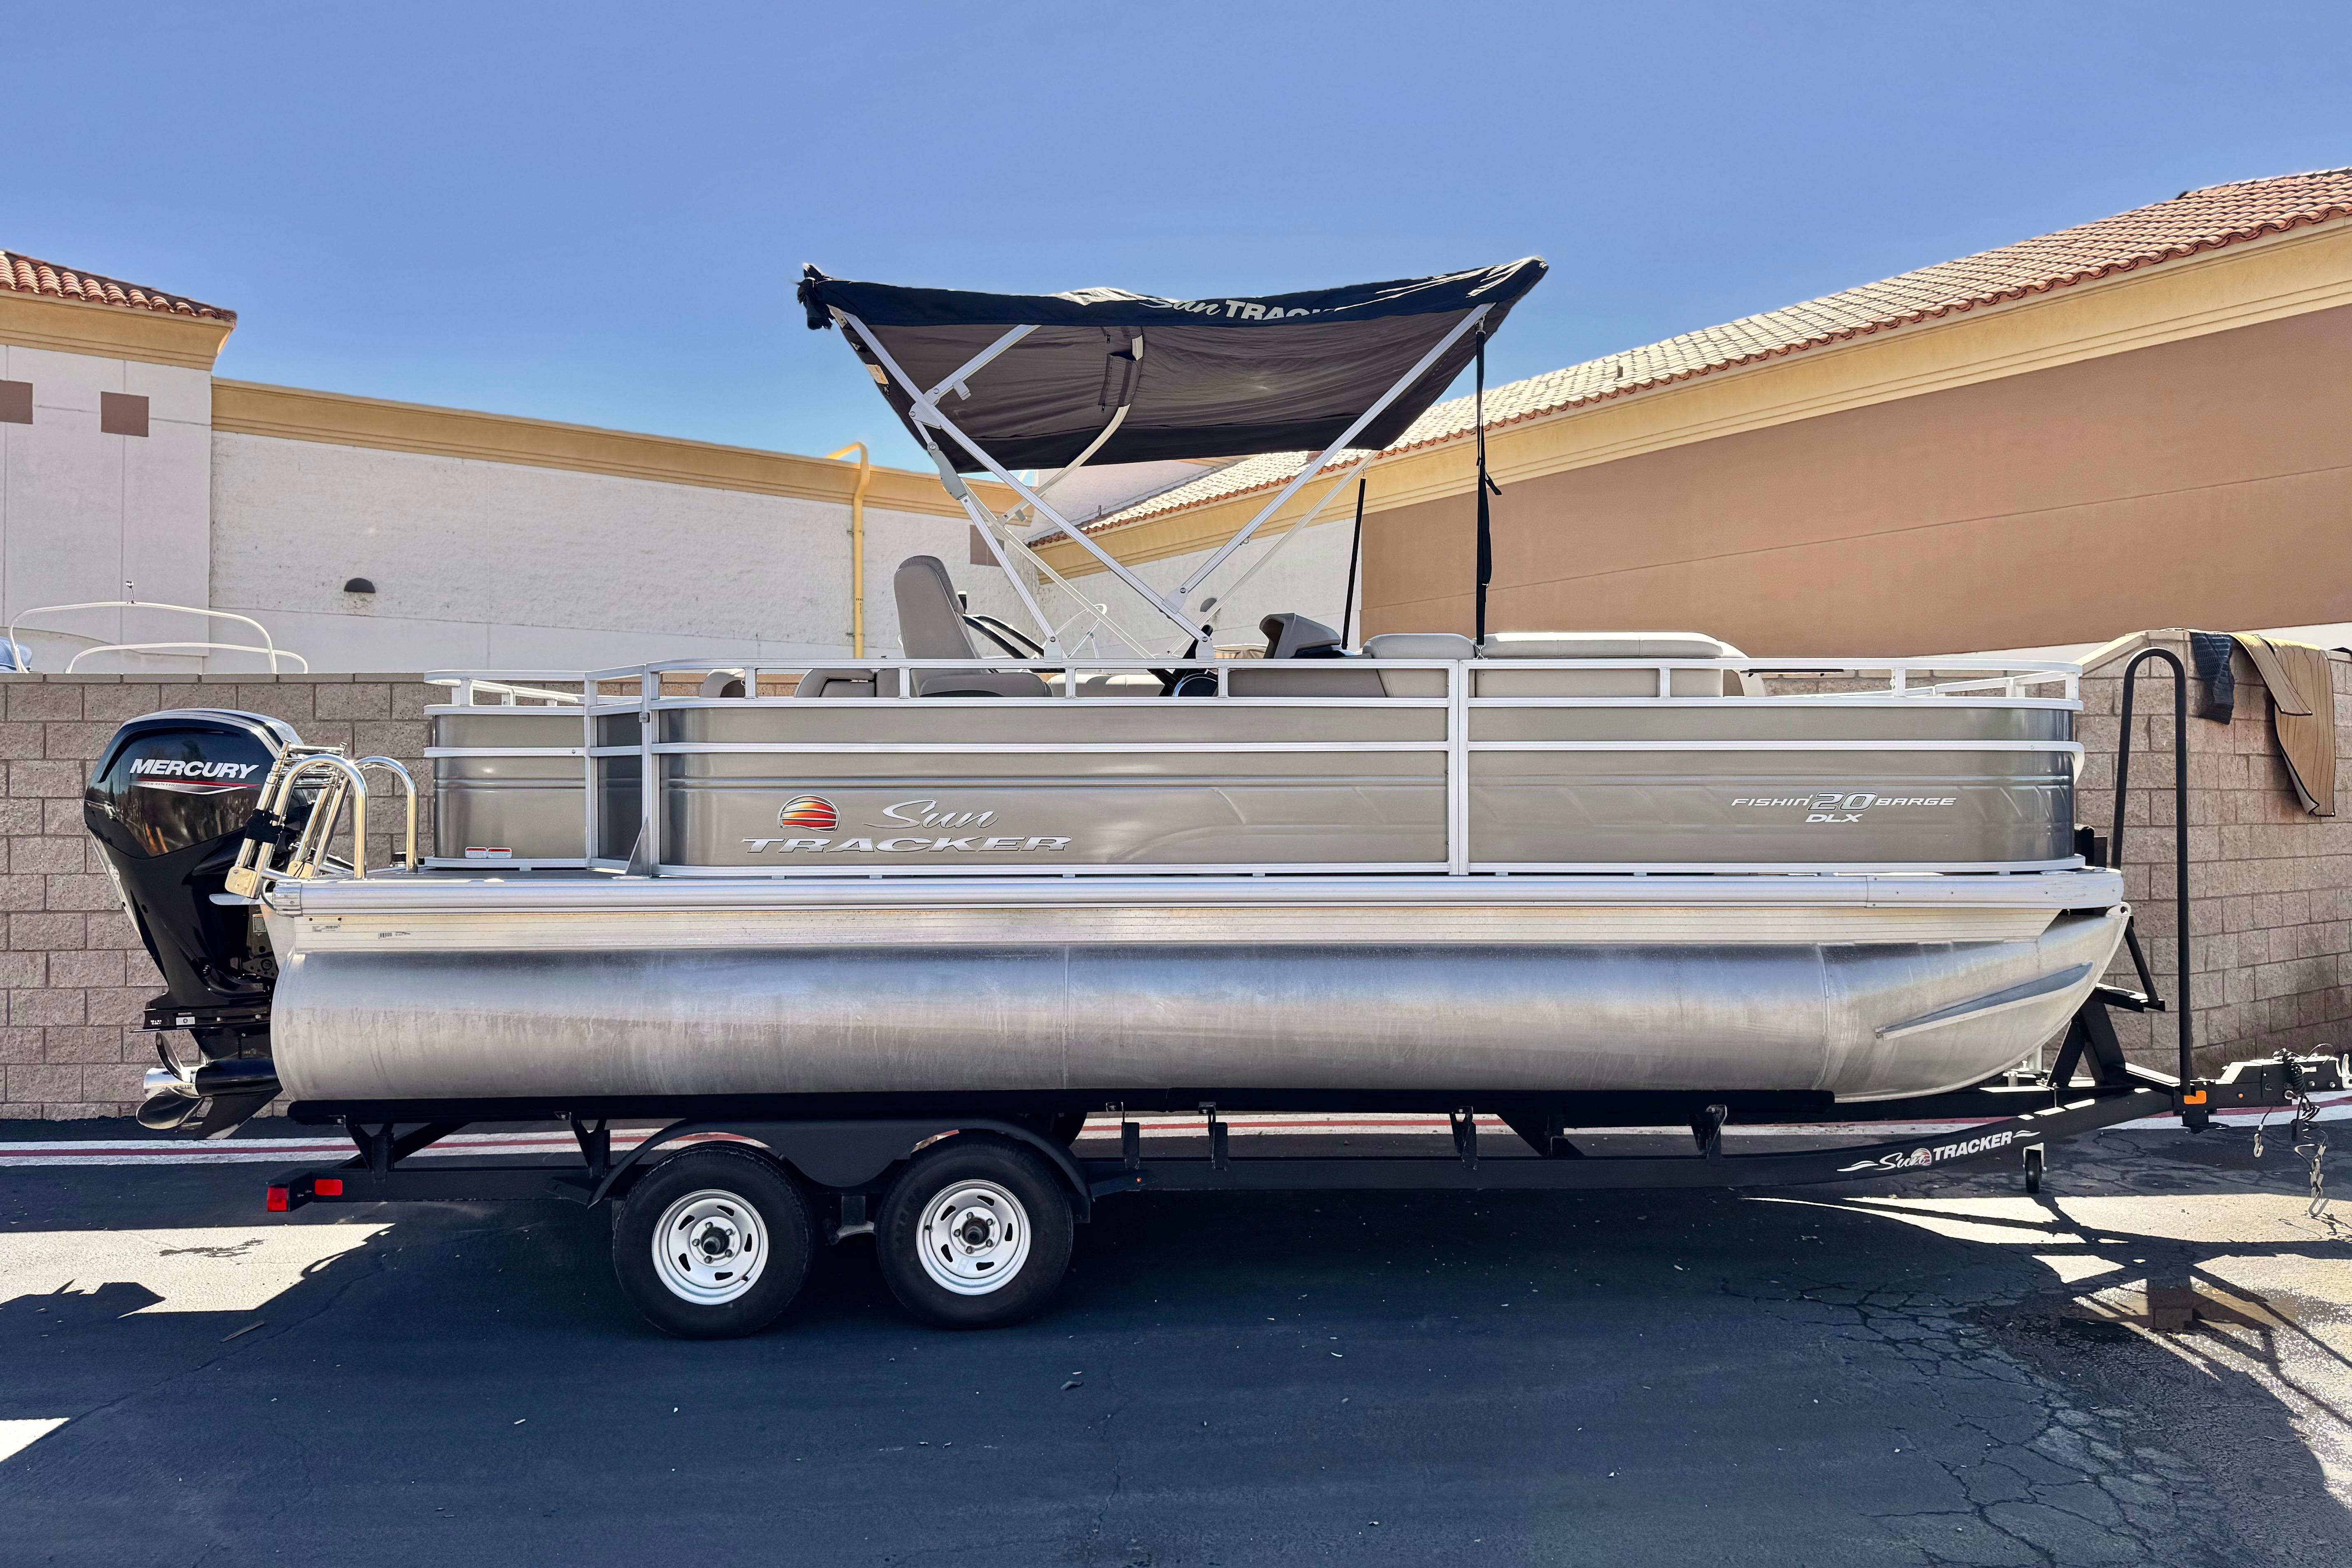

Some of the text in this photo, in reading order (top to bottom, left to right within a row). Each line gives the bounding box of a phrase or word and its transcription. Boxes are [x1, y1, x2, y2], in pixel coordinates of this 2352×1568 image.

[129, 758, 259, 779] MERCURY
[1807, 792, 1877, 811] 20
[862, 799, 999, 829] Sun
[1805, 814, 1862, 823] DLX
[741, 835, 1072, 854] TRACKER
[1874, 1131, 2013, 1170] Sun TRACKER
